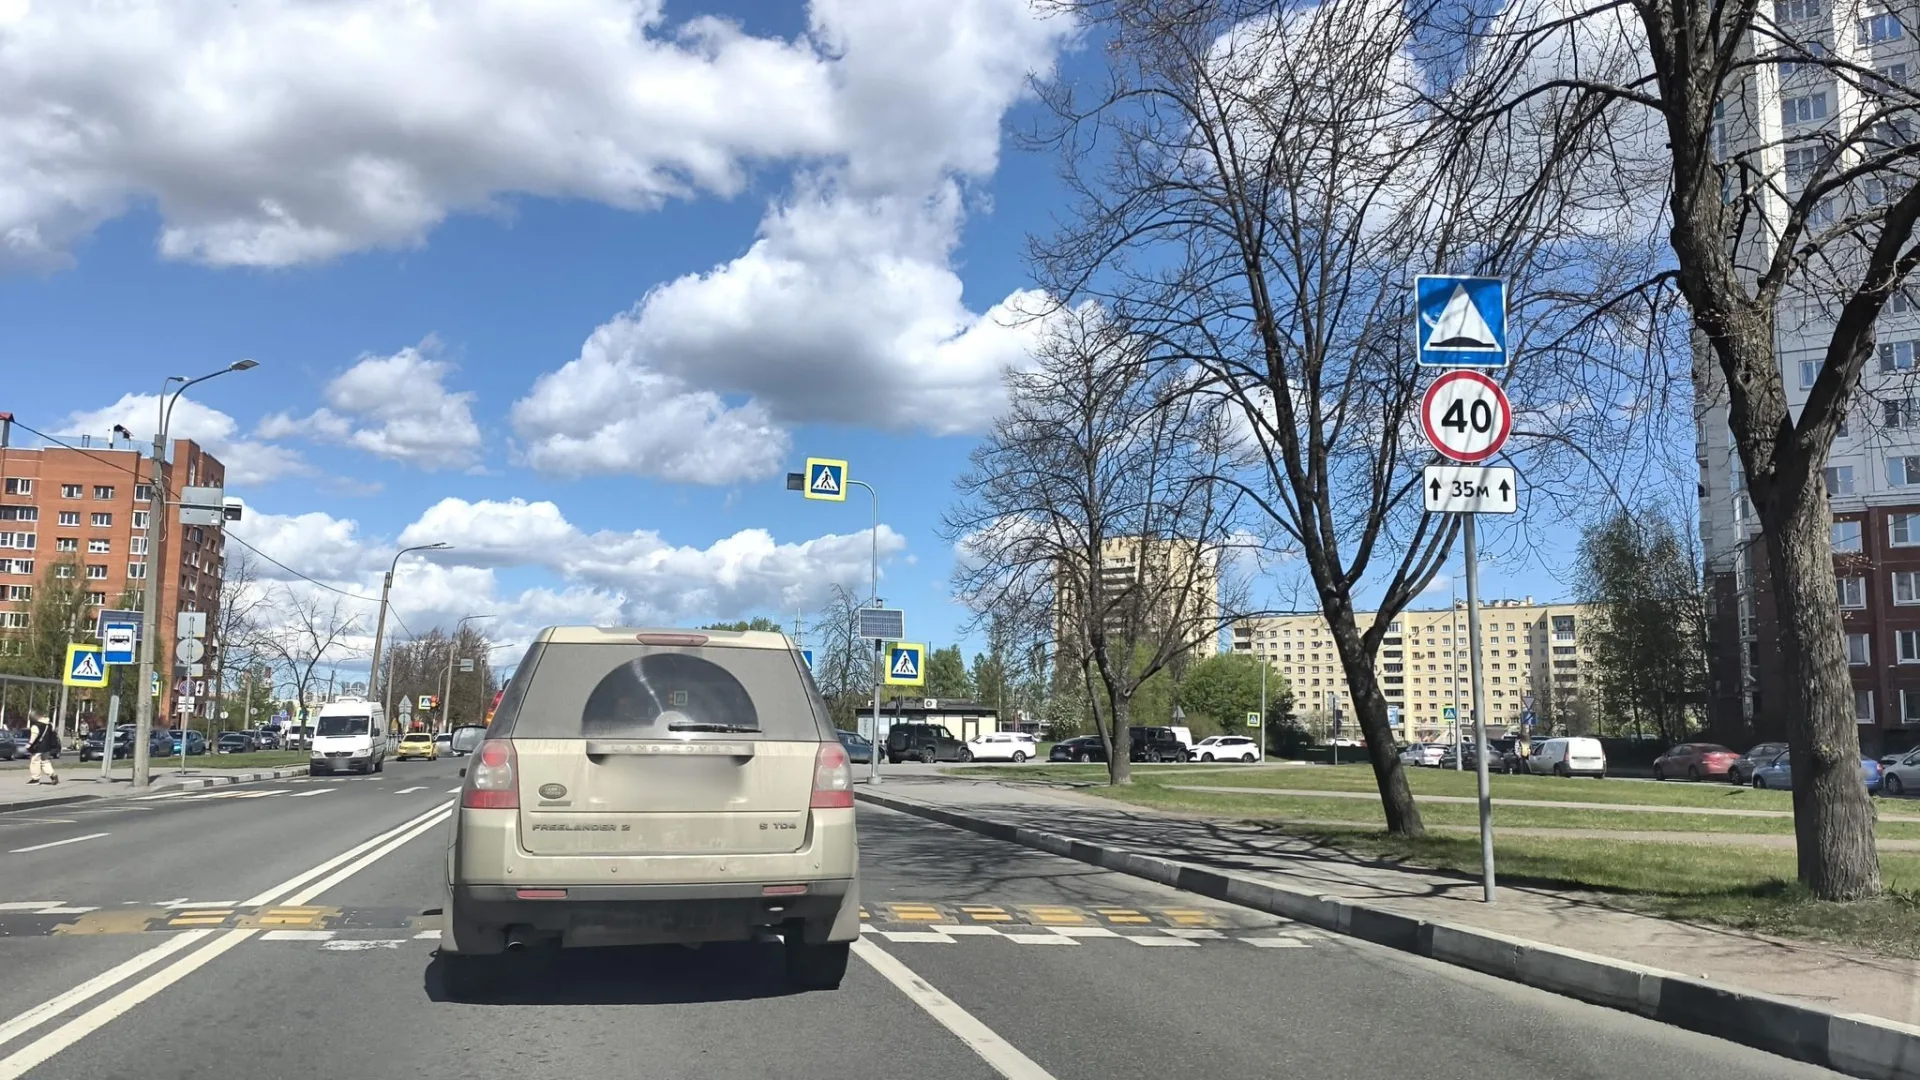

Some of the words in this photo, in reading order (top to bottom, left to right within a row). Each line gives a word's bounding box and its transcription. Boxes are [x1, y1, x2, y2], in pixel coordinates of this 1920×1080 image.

[1441, 398, 1492, 434] 40
[532, 823, 617, 832] FREELANDER
[621, 823, 631, 832] 2
